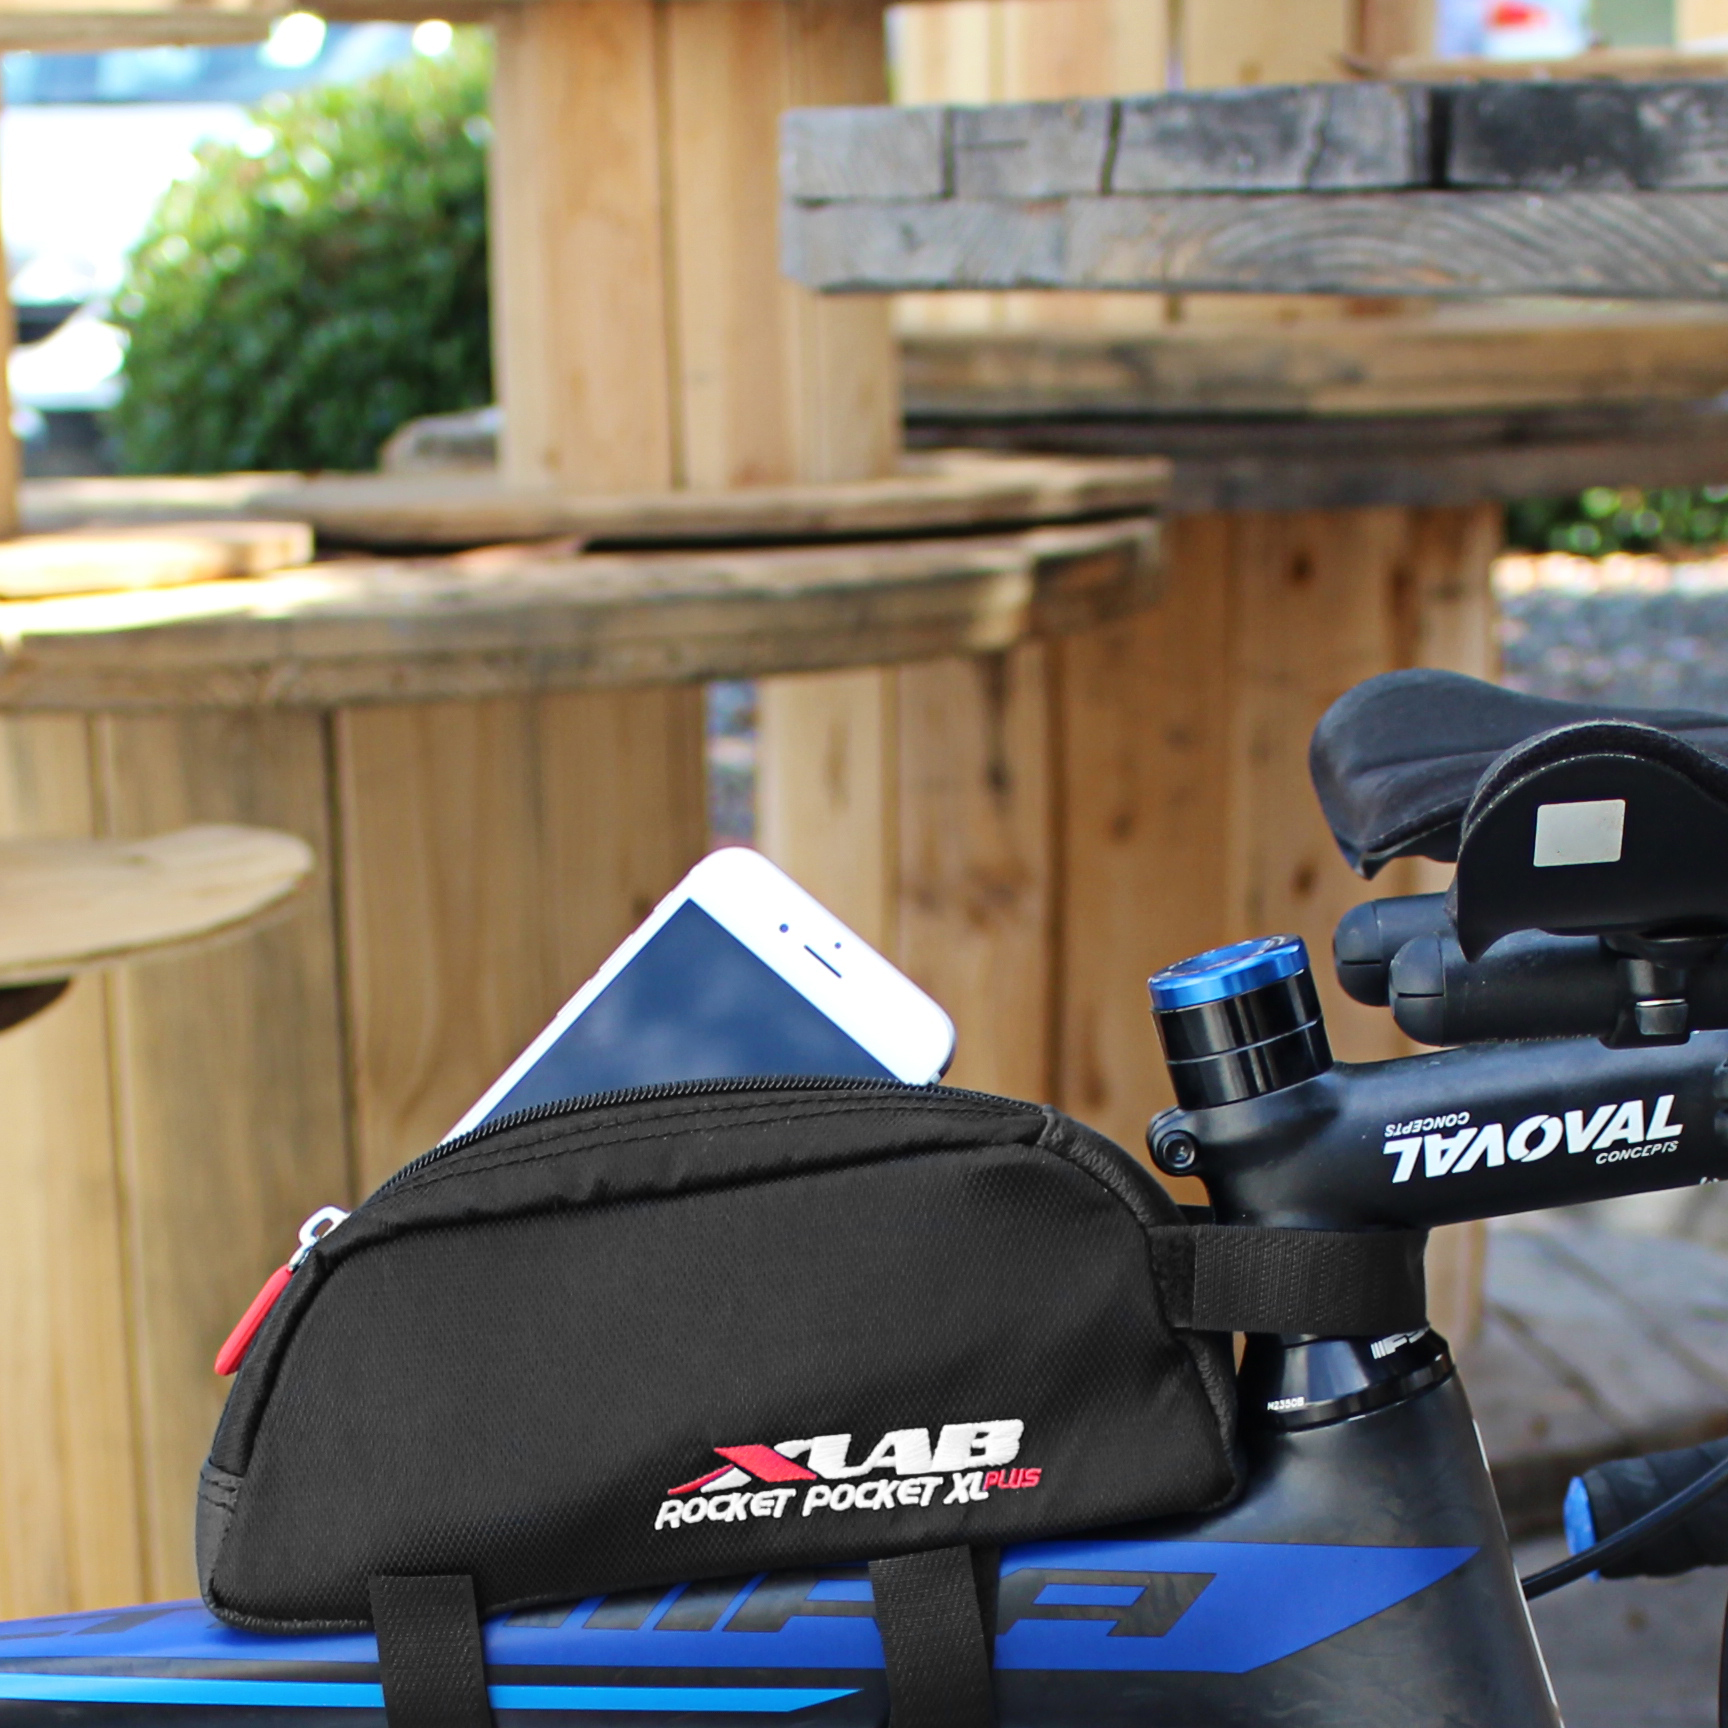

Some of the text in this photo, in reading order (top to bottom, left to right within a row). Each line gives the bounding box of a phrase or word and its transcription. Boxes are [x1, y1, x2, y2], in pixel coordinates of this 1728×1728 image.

[1383, 1110, 1471, 1139] CONCEPTS
[1595, 1139, 1680, 1166] CONCEPTS
[668, 1418, 1025, 1494] XLAB
[654, 1467, 1043, 1531] ROCKET POCKET XL PLUS
